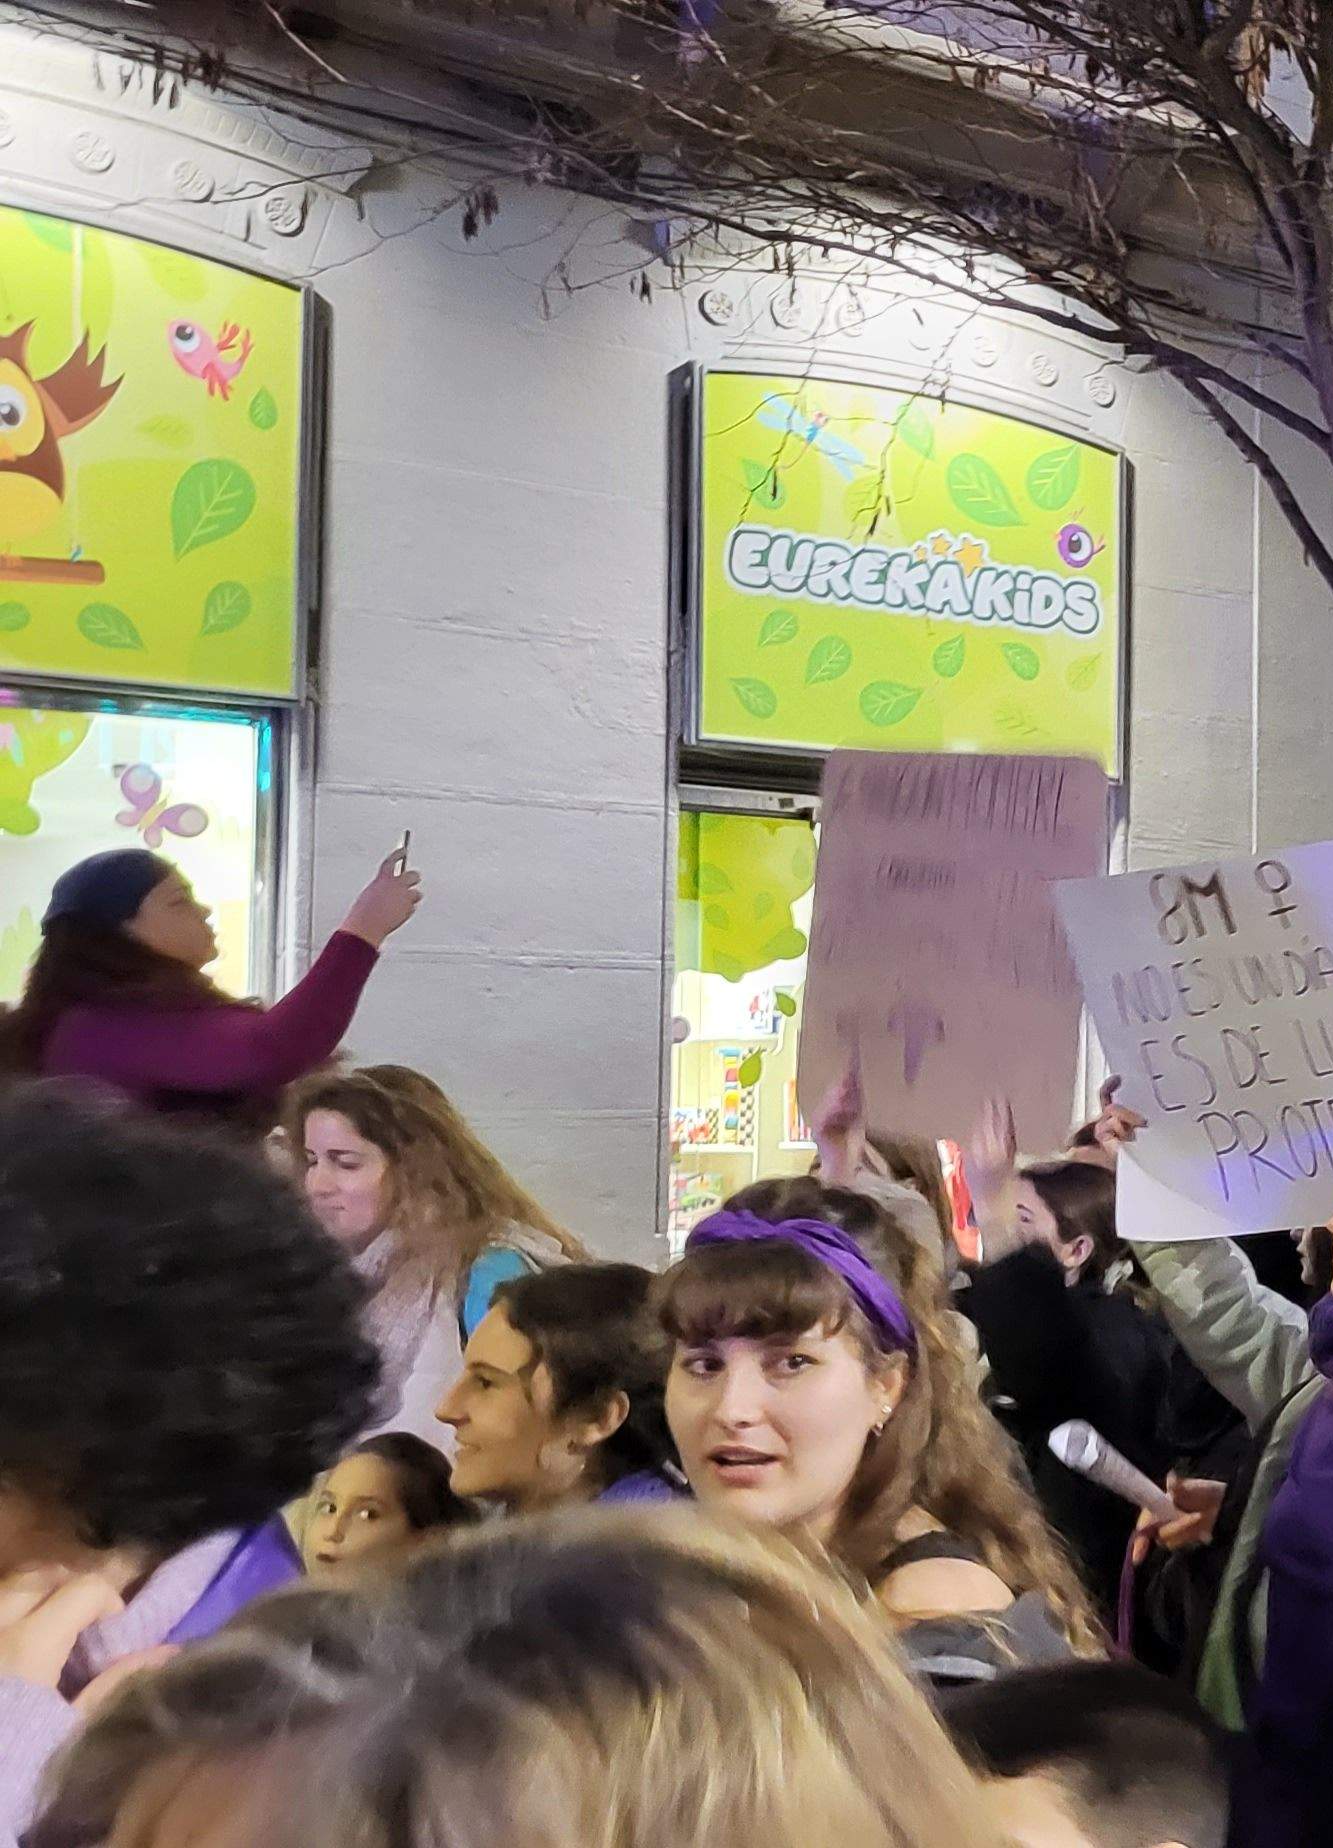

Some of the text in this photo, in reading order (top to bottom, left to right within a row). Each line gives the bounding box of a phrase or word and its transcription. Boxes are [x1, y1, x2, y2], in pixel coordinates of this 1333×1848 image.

[1148, 868, 1238, 945] 8M
[1112, 965, 1171, 1025] NO
[1171, 957, 1226, 1017] ES
[1140, 1035, 1218, 1113] ES
[1221, 1025, 1287, 1090] DE
